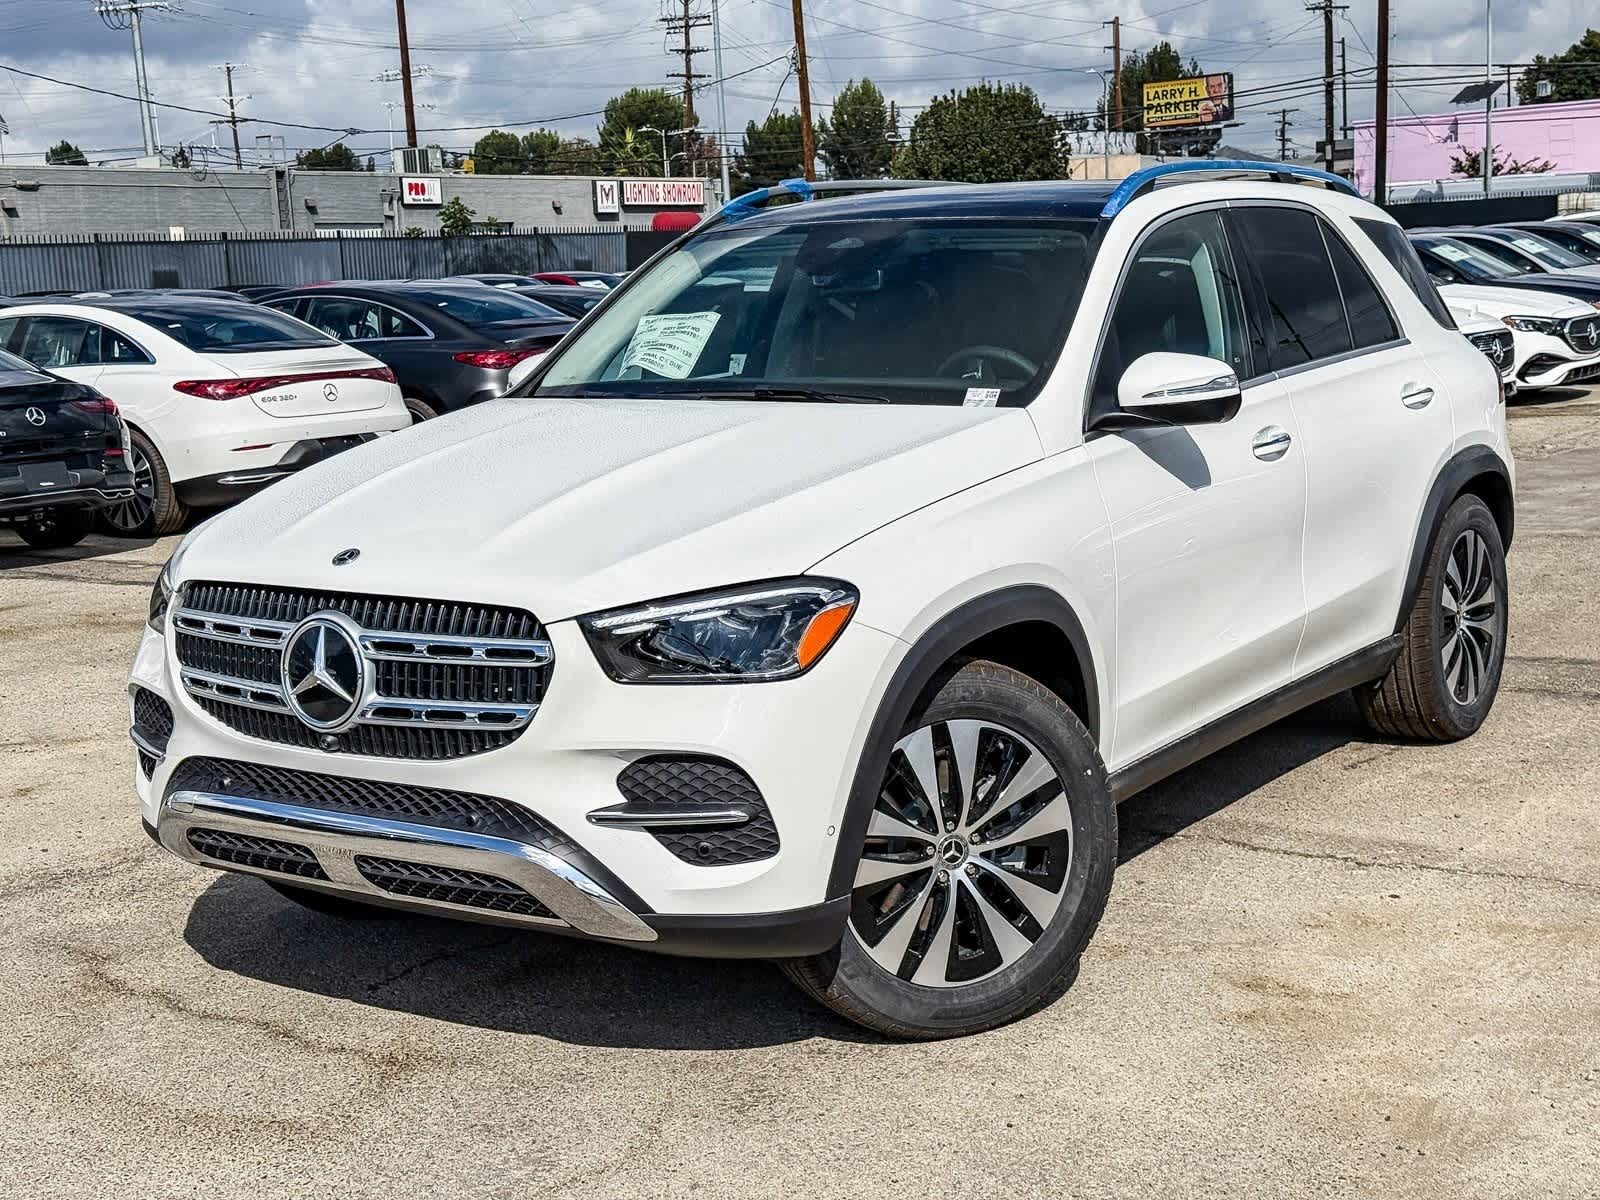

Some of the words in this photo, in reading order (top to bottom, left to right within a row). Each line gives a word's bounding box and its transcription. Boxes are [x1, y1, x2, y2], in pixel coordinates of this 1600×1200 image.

[1146, 88, 1185, 102] LARRY
[1146, 100, 1199, 115] PARKER
[625, 183, 660, 203] LIGHTING
[662, 183, 702, 203] SHOWROOM
